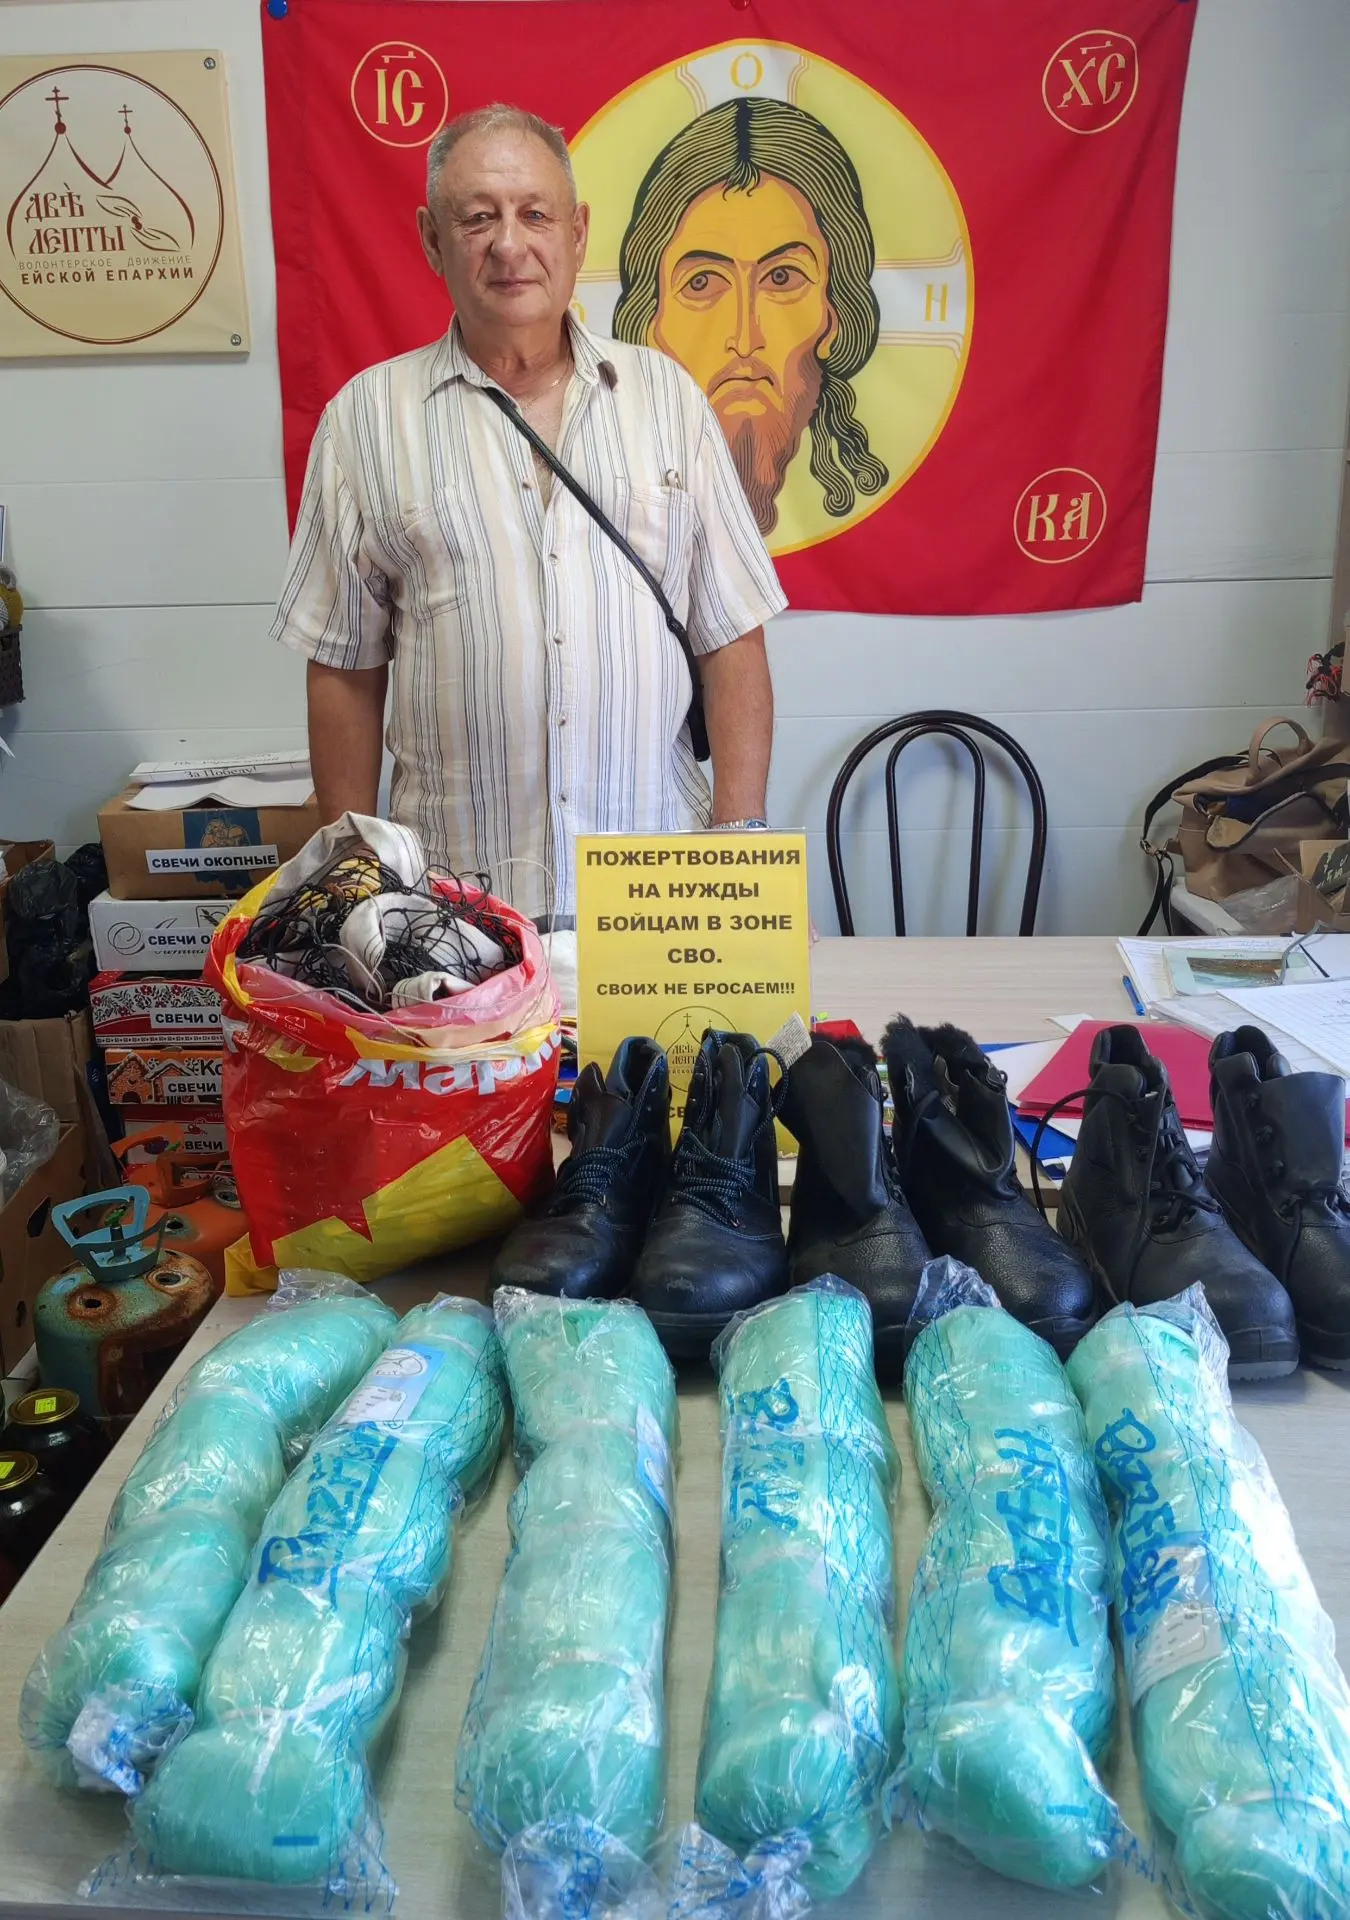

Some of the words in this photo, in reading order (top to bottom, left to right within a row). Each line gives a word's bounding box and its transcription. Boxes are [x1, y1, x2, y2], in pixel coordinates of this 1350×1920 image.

[19, 258, 113, 270] ВОЛОНТЕРСКОЕ
[127, 255, 192, 267] ДВИЖЕНИЕ
[21, 268, 96, 285] ЕЙСКОЙ
[106, 267, 194, 282] ЕПАРХИИ
[152, 857, 199, 869] СВЕЧИ
[204, 854, 277, 867] ОКОПНЫЕ
[586, 849, 800, 867] ПОЖЕРТВОВАНИЯ
[628, 883, 660, 899] НА
[668, 882, 759, 901] НУЖДЫ
[597, 913, 700, 934] БОЙЦАМ
[707, 915, 722, 931] В
[729, 914, 793, 931] ЗОНЕ
[148, 935, 197, 946] СВЕЧИ
[667, 948, 722, 965] СВО.
[596, 983, 658, 996] СВОИХ
[664, 983, 688, 996] НЕ
[693, 982, 796, 996] БРОСАЕМ!!!
[155, 1013, 204, 1024] СВЕЧИ
[168, 1083, 217, 1093] СВЕЧИ
[182, 1140, 223, 1151] ВЕЧИ
